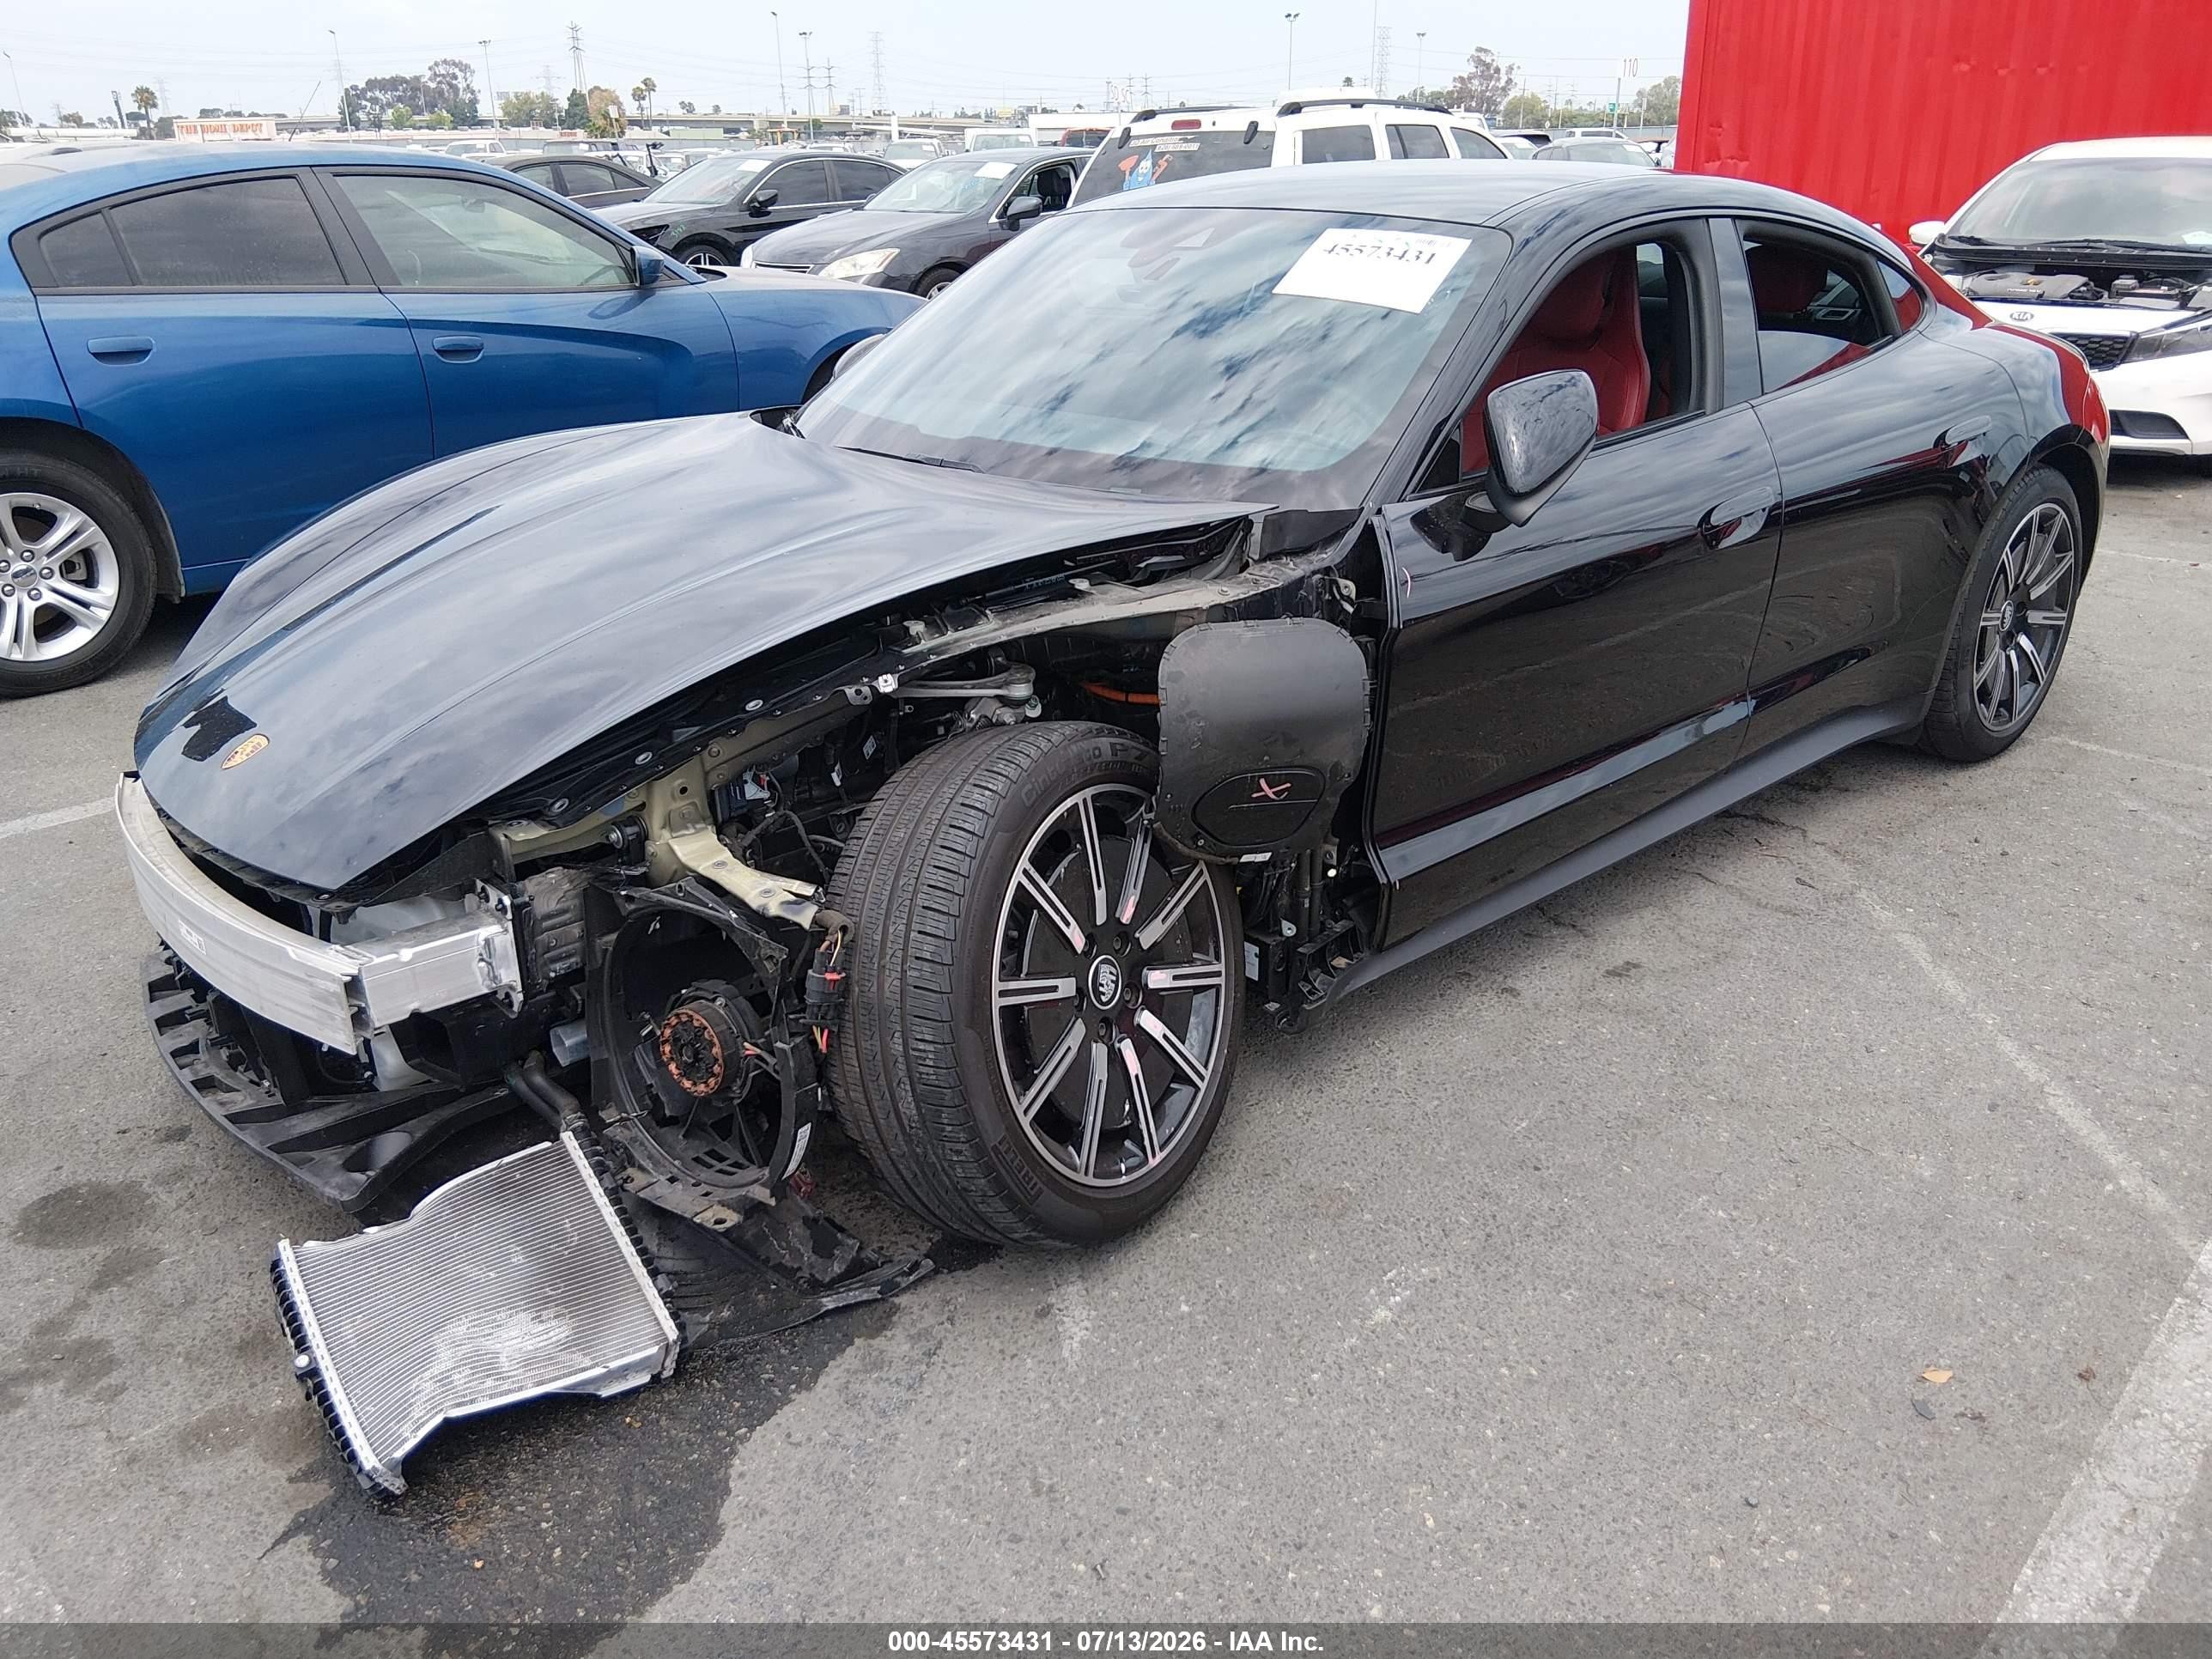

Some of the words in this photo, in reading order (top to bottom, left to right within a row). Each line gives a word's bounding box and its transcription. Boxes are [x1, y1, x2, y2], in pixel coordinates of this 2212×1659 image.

[1622, 58, 1638, 77] 110
[232, 123, 263, 133] DEPOT
[1323, 242, 1437, 265] 45573431
[2011, 312, 2033, 321] KIA
